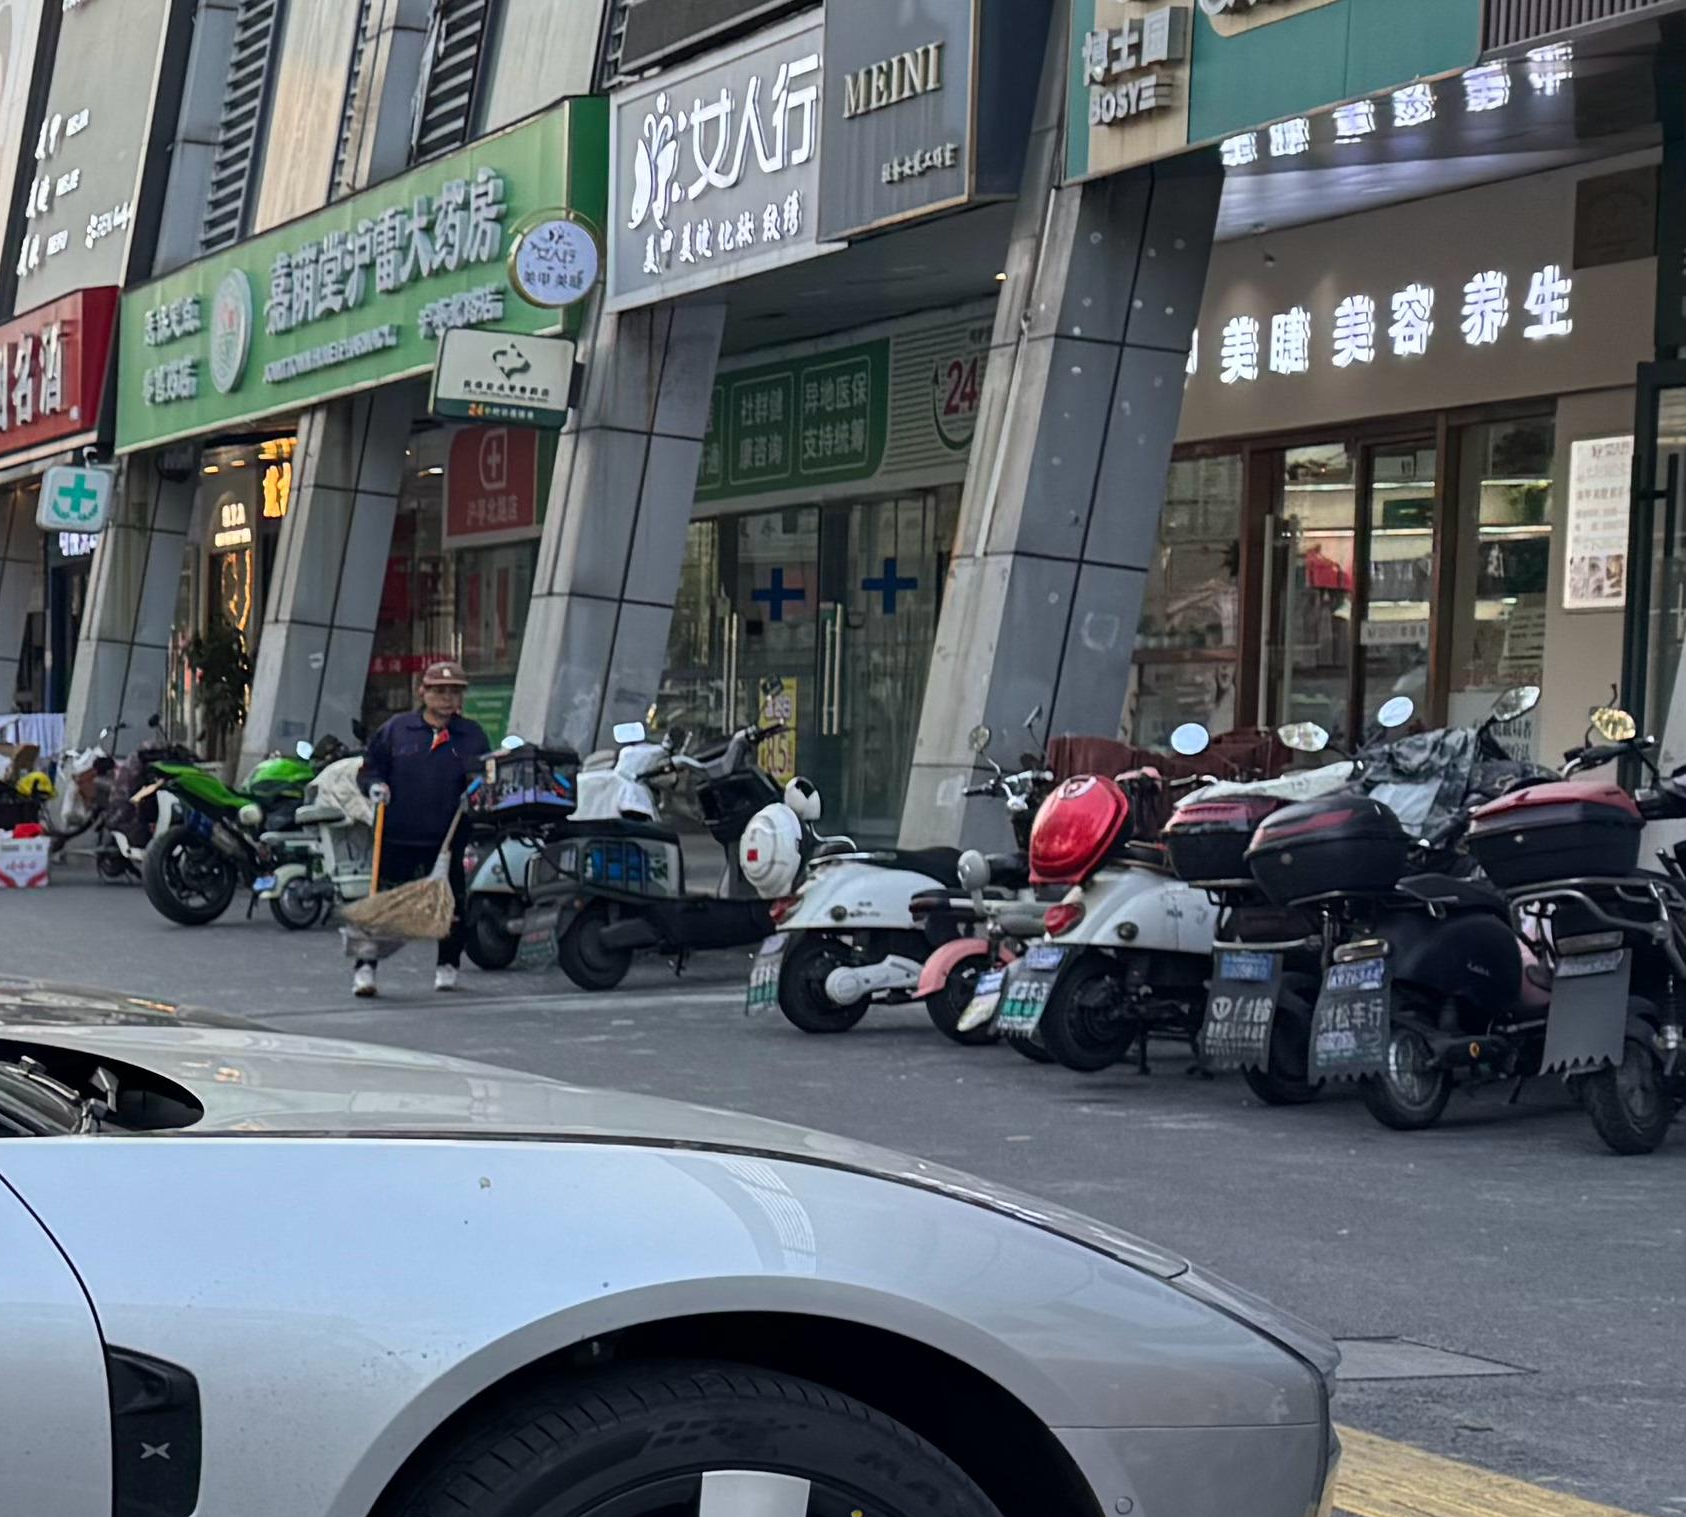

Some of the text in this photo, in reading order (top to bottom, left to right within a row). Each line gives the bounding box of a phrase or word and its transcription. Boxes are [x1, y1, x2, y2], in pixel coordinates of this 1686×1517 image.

[688, 53, 822, 200] 女人行
[843, 41, 945, 119] MEINI
[264, 166, 508, 336] 嘉荫堂沪雷大药房
[1220, 264, 1573, 384] 美睫 美容 养生
